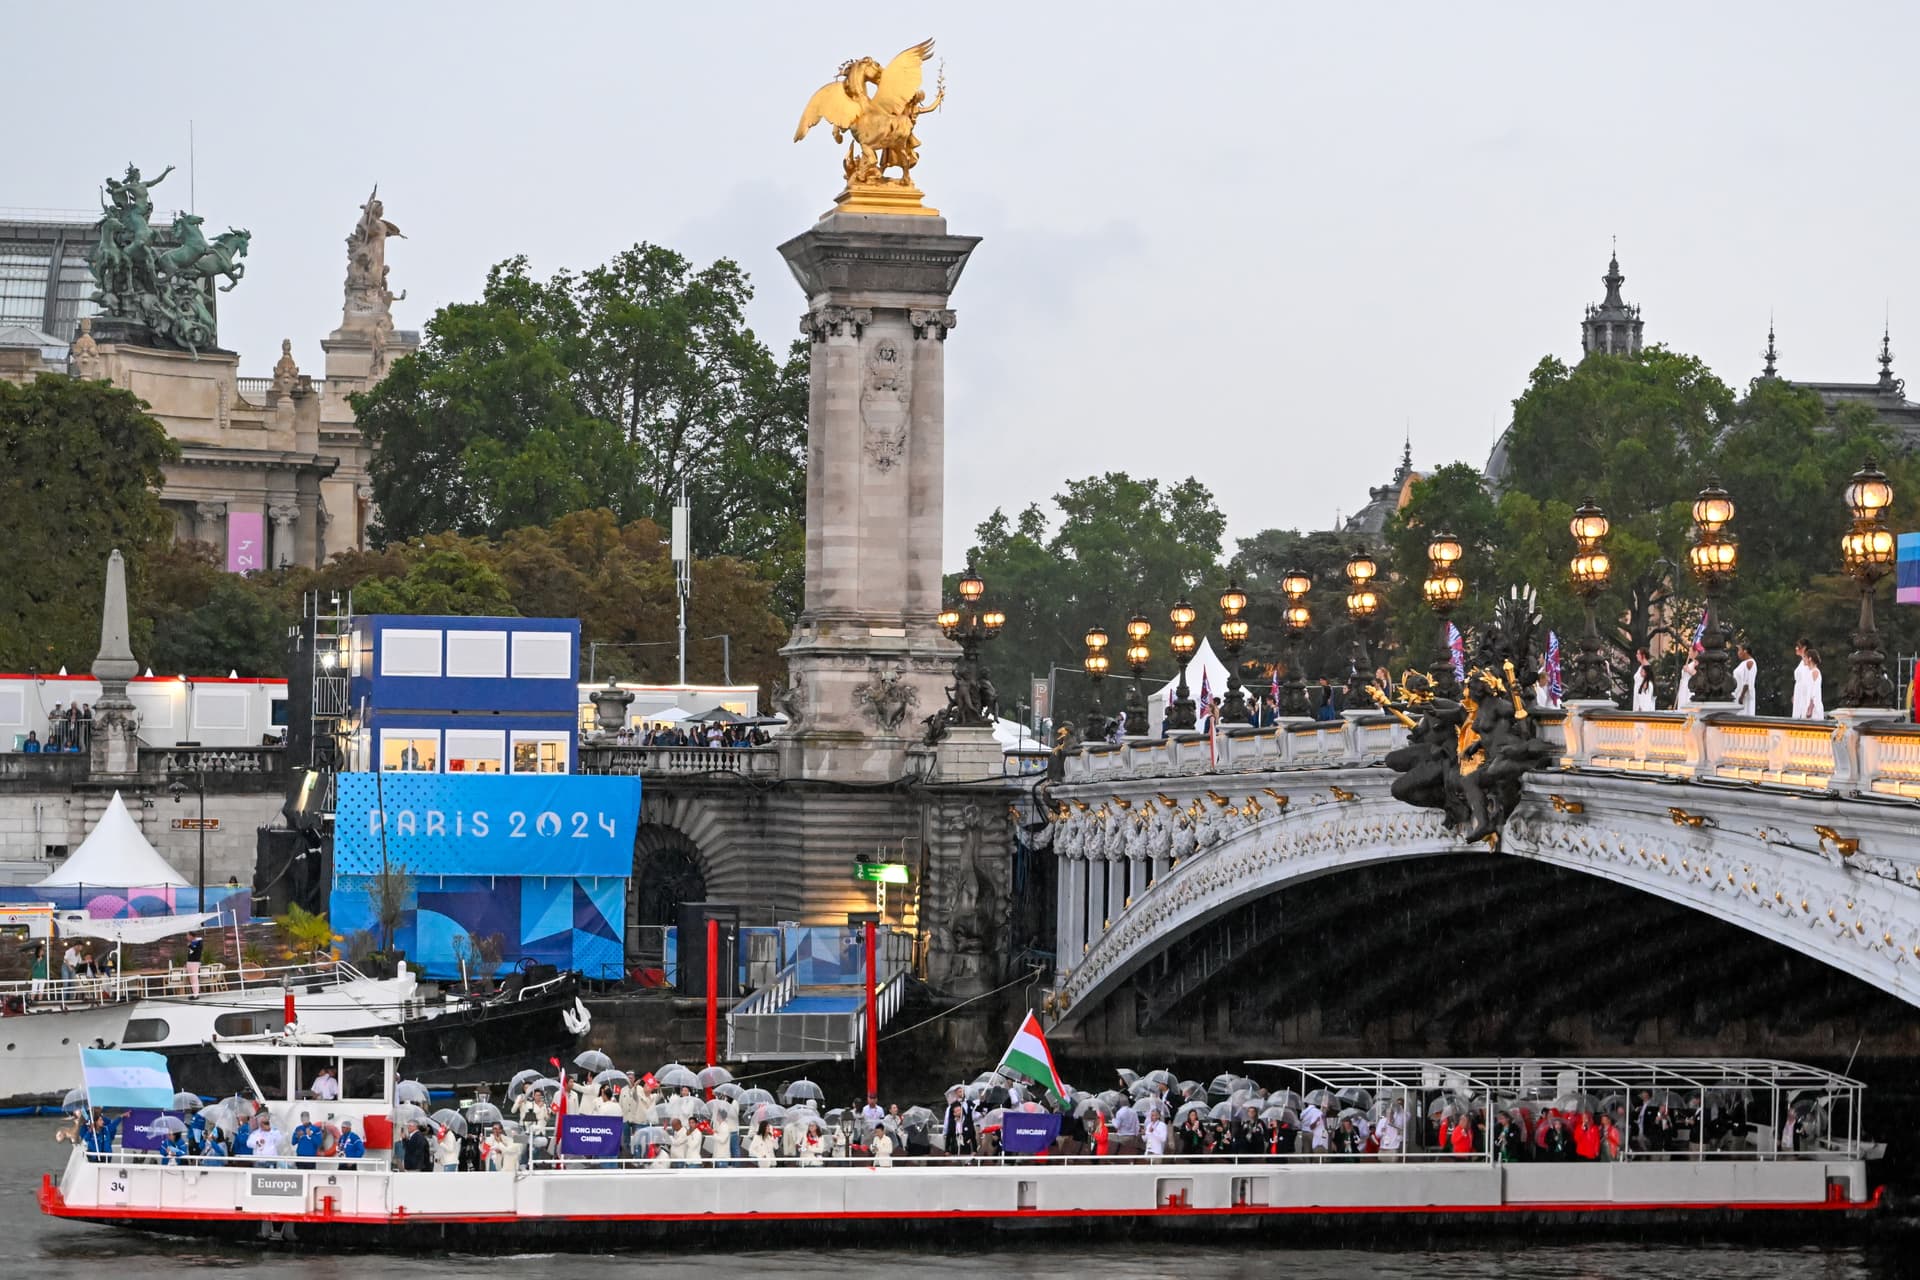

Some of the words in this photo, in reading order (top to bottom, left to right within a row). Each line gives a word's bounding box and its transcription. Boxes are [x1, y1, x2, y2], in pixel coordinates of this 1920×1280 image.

[509, 811, 616, 838] 2024
[581, 1135, 602, 1143] CHINA
[110, 1181, 125, 1193] 34
[257, 1177, 297, 1192] Europa
